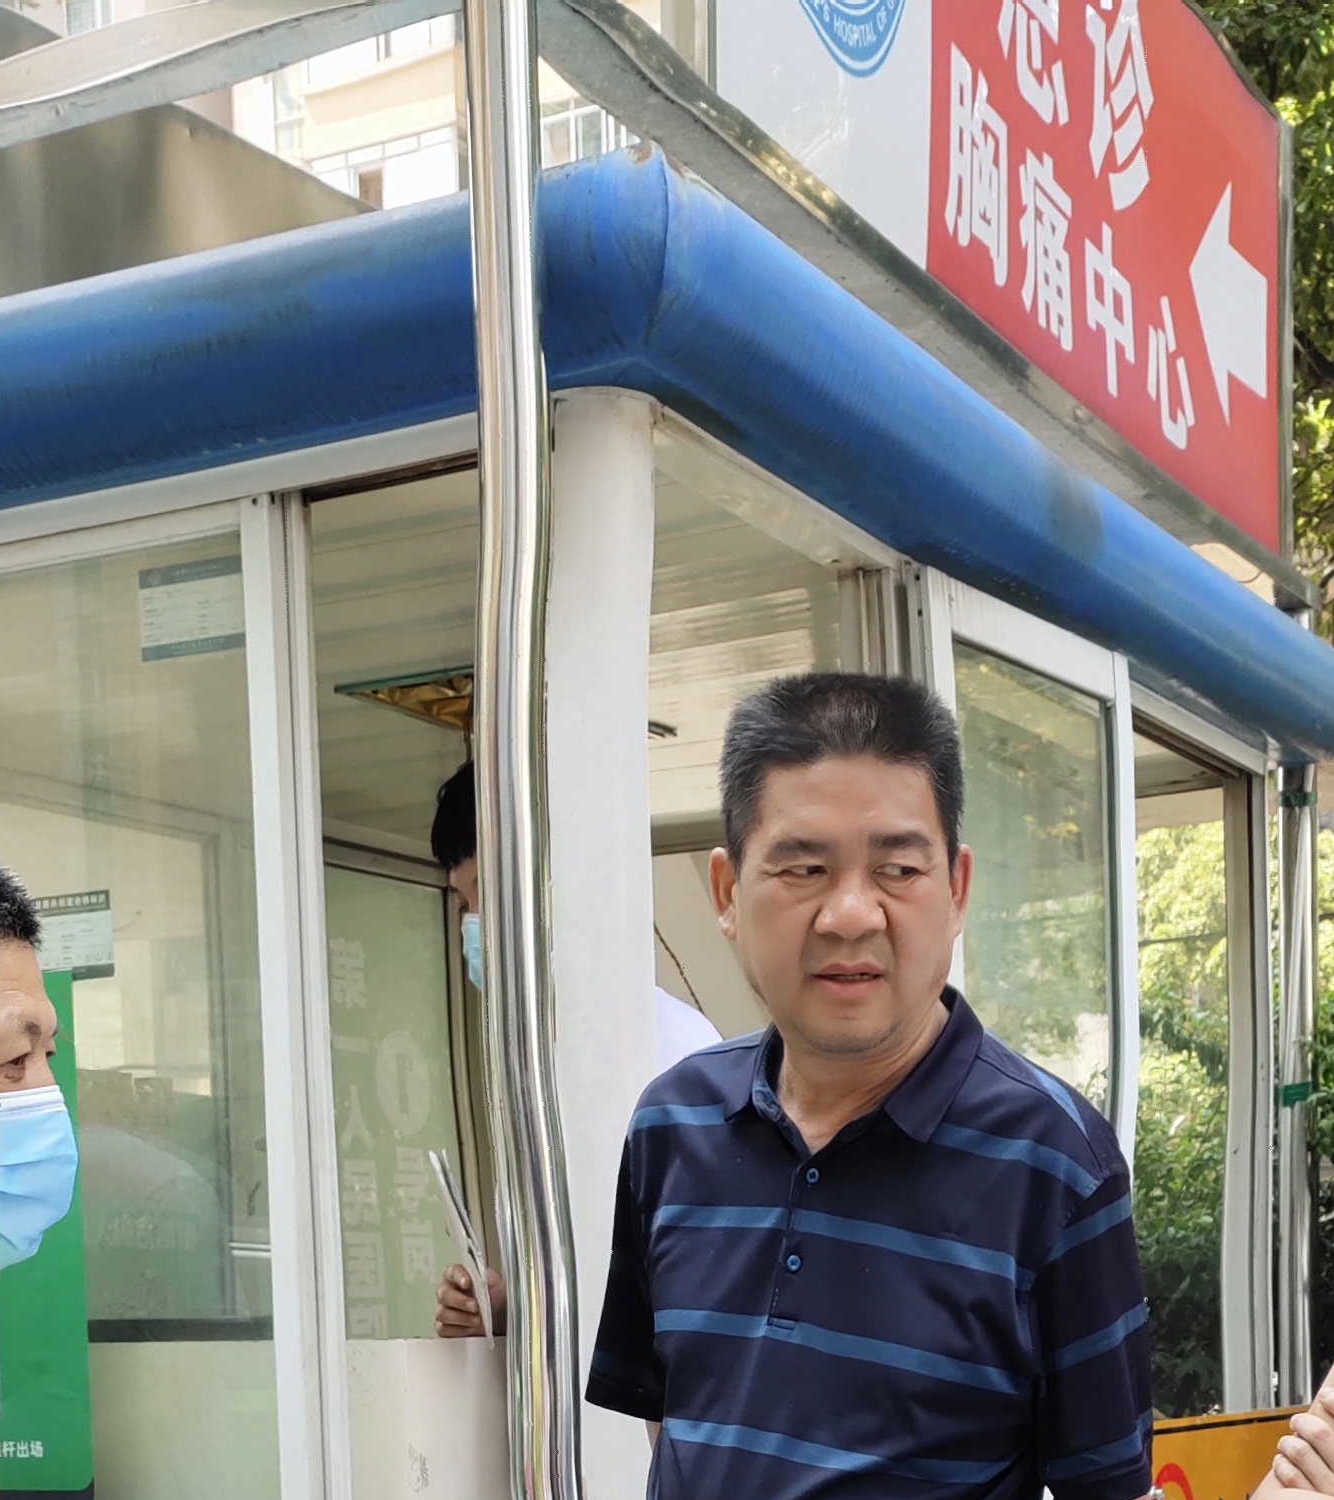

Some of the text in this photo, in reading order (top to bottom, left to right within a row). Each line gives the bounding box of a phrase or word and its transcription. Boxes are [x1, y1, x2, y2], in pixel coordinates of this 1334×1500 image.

[833, 14, 877, 48] HOSPITAL
[945, 42, 1196, 450] 胸痛中心
